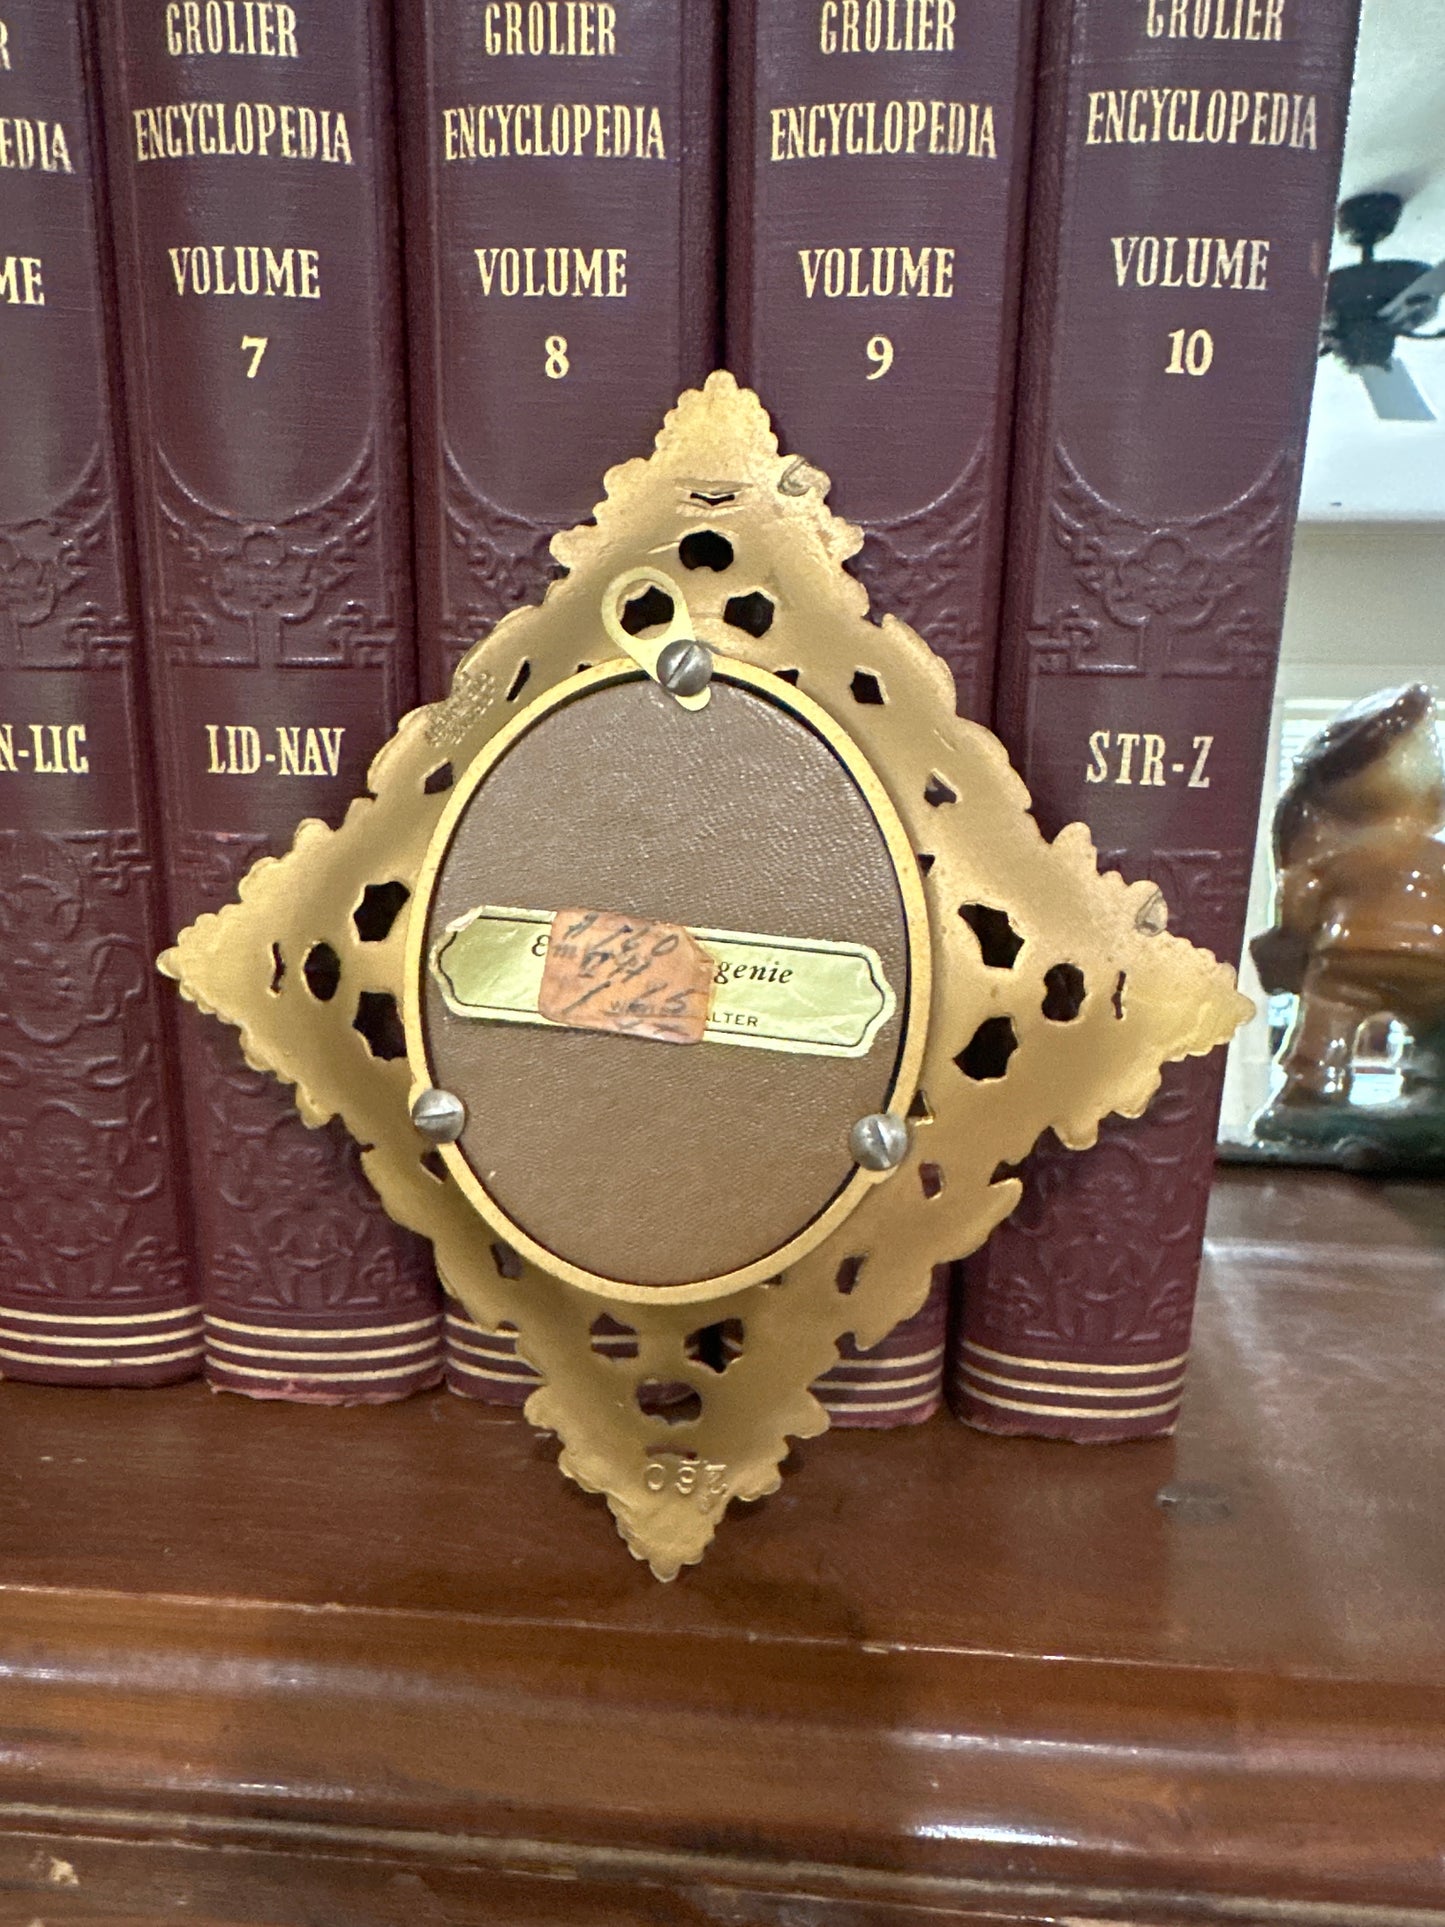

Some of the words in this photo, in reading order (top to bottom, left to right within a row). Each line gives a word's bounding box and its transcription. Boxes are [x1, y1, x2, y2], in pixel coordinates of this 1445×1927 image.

[166, 0, 300, 58] GROLIER
[484, 1, 617, 57] GROLIER
[820, 0, 957, 55] GROLIER
[1146, 0, 1285, 42] GROLIER
[133, 102, 354, 165] ENCYCLOPEDIA
[443, 103, 666, 161] ENCYCLOPEDIA
[770, 100, 997, 161] ENCYCLOPEDIA
[1085, 88, 1317, 151] ENCYCLOPEDIA
[168, 245, 321, 299] VOLUME
[474, 247, 627, 298] VOLUME
[798, 246, 955, 299] VOLUME
[1111, 236, 1270, 291] VOLUME
[240, 335, 269, 378] 7
[544, 335, 570, 379] 8
[866, 335, 894, 380] 9
[1164, 328, 1214, 376] 10
[0, 723, 89, 775] N-LIC
[205, 724, 346, 777] LID-NAV
[1086, 730, 1215, 788] STR-Z
[713, 961, 793, 985] genie
[705, 1012, 758, 1027] LTER
